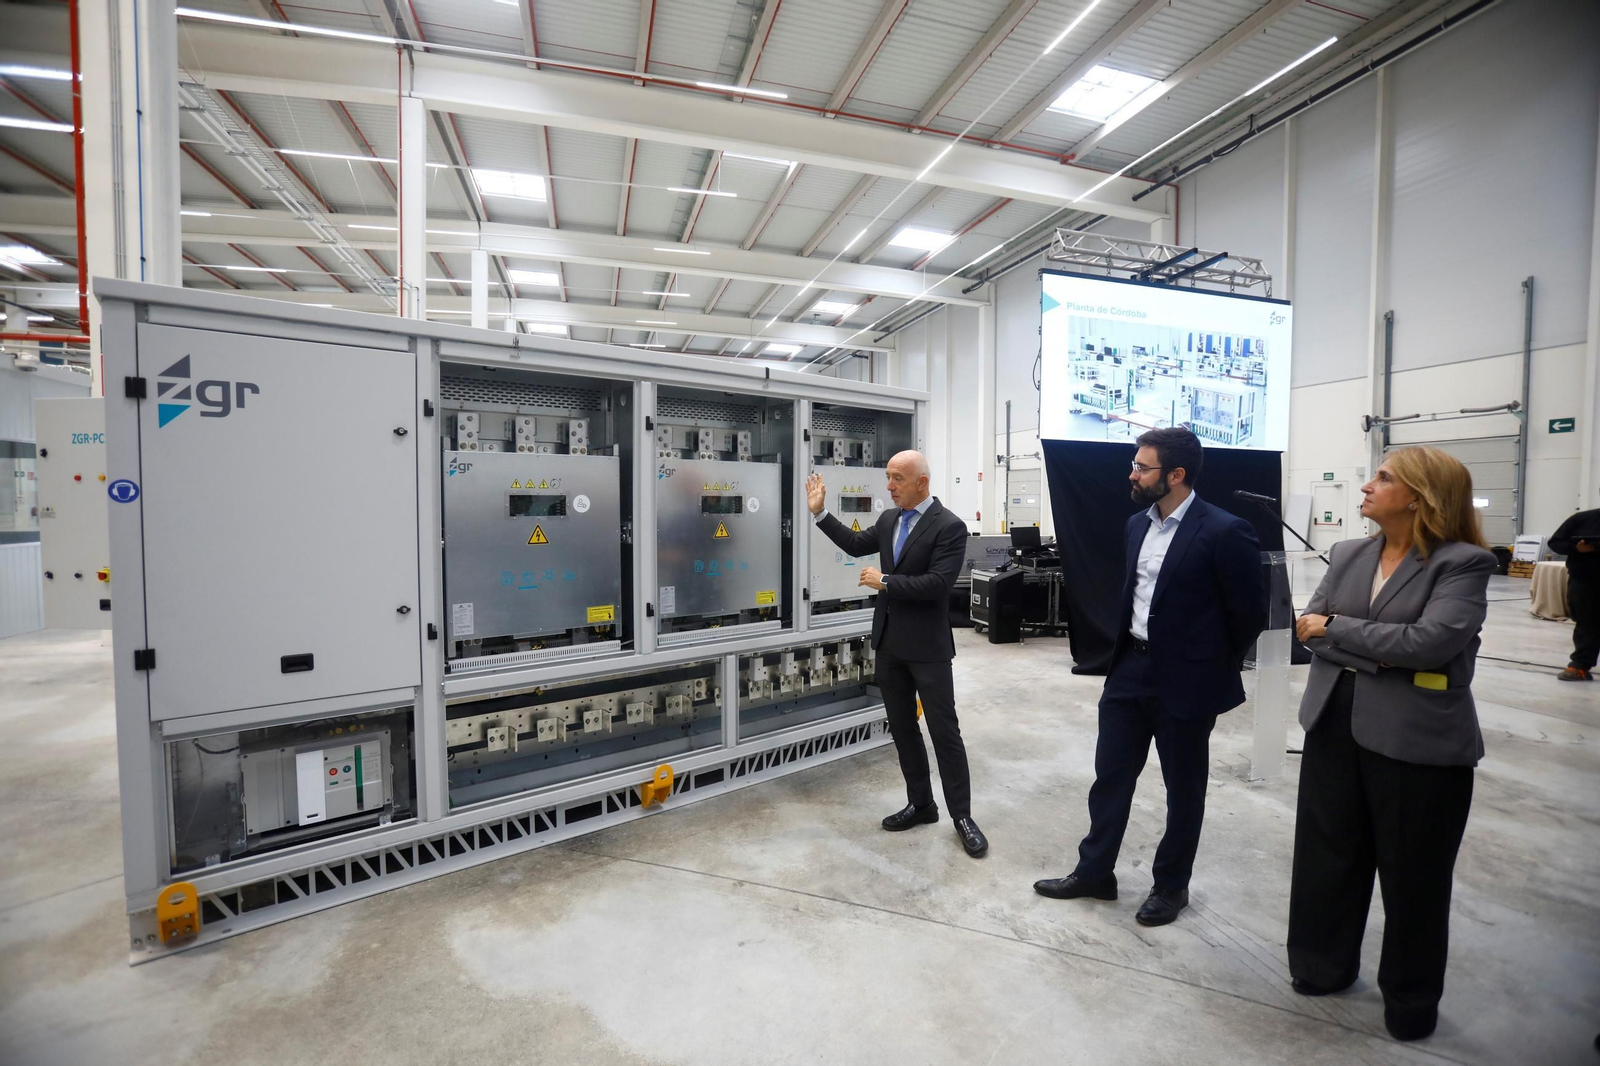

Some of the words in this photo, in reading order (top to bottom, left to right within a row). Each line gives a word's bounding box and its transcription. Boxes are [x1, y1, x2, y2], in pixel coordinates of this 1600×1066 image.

[1066, 302, 1095, 313] Planta
[1097, 306, 1108, 314] de
[1110, 307, 1147, 319] Córdoba
[71, 433, 105, 444] ZGR-PC
